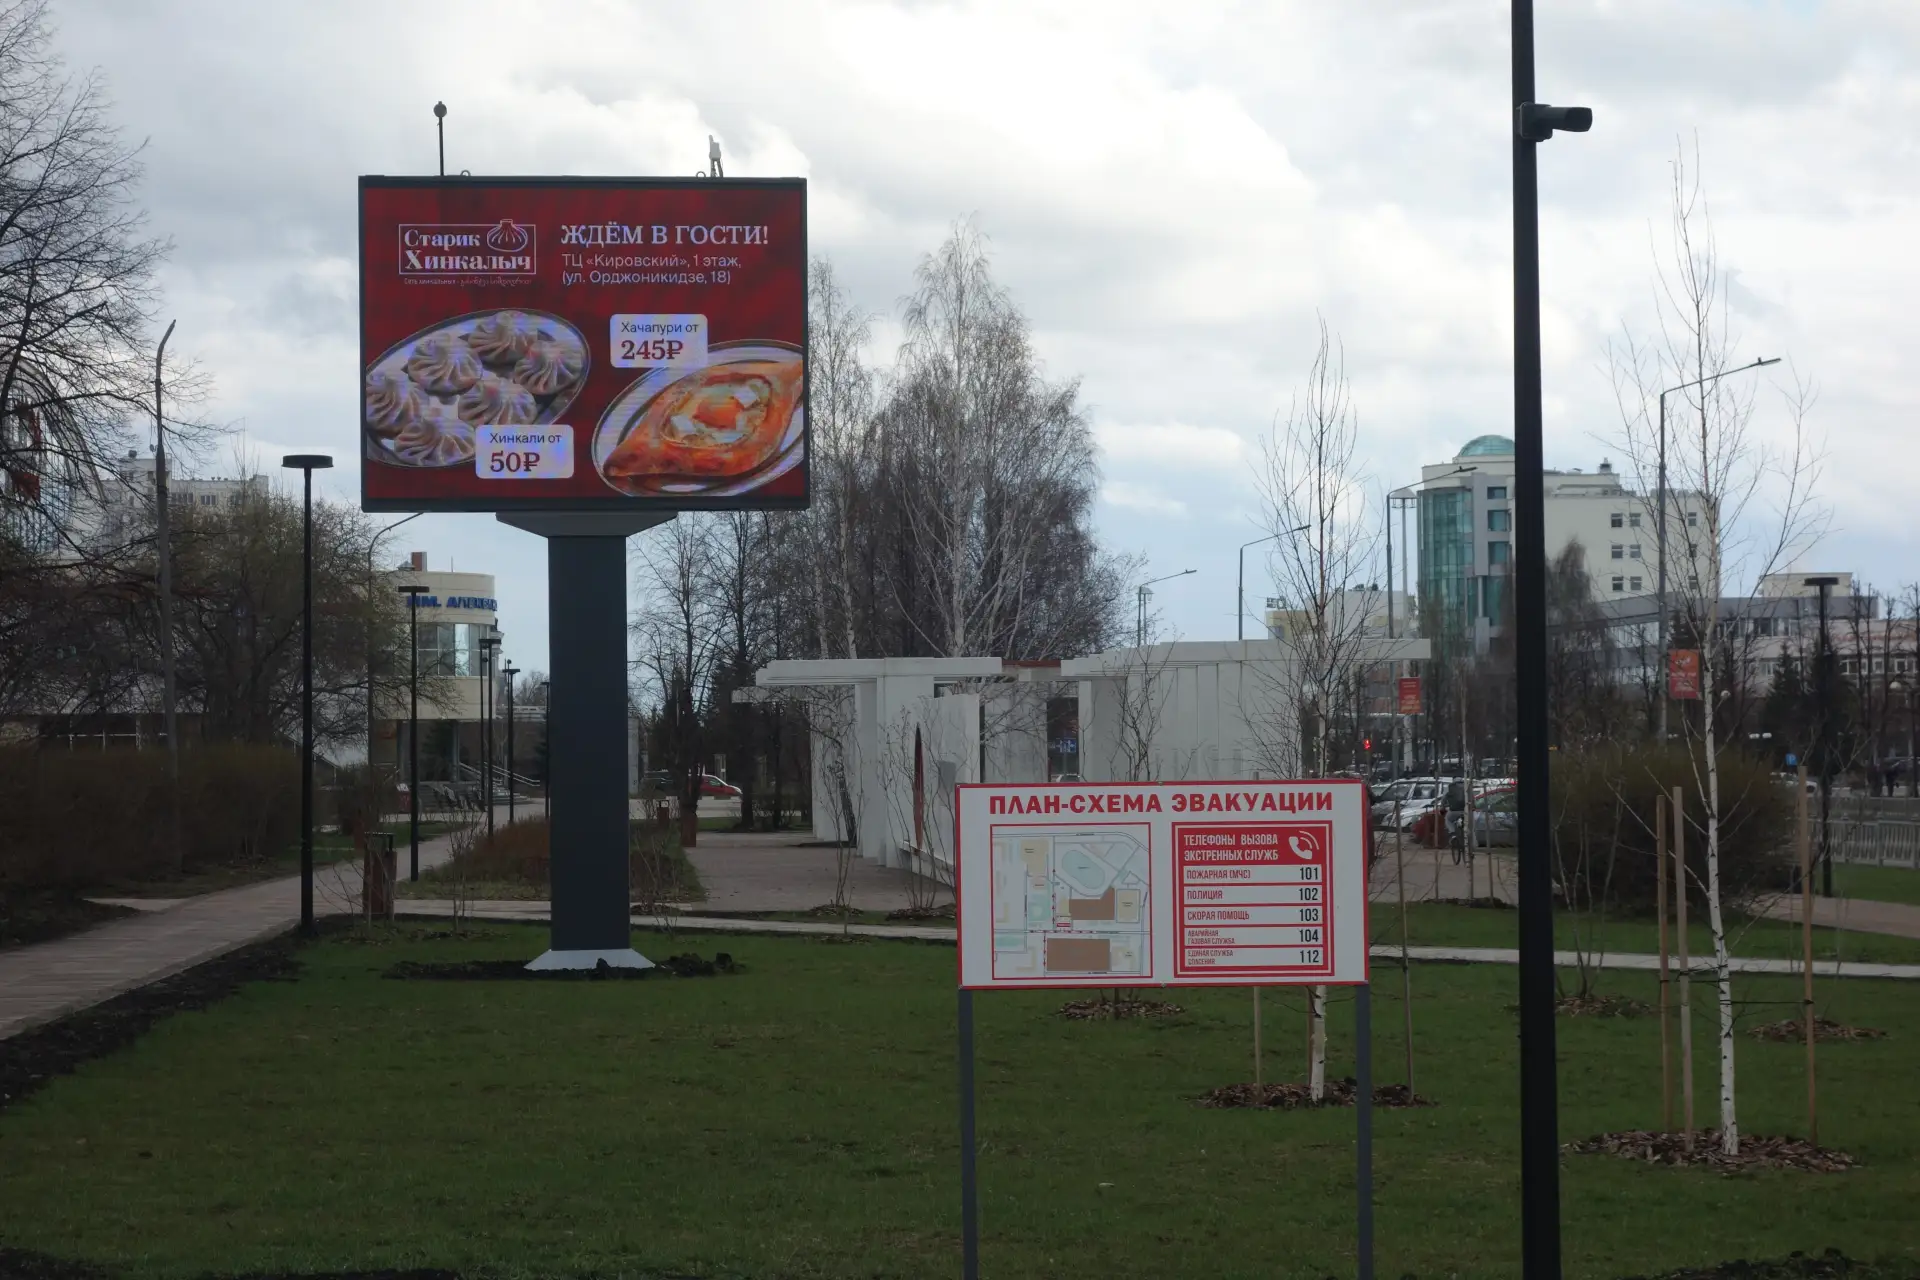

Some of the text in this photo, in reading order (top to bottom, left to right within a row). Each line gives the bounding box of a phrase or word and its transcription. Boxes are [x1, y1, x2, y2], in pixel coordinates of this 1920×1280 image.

[404, 229, 481, 251] Старик
[561, 221, 769, 248] ЖДЁМ В ГОСТИ!
[405, 250, 531, 270] Хинкалыч
[561, 253, 583, 268] ТЦ
[586, 253, 690, 269] «Кировский»,
[702, 257, 742, 269] этаж,
[562, 270, 731, 286] (ул. Орджоникидзе, 18)
[621, 321, 699, 337] Хачапури от
[489, 432, 562, 445] Хинкали от
[989, 792, 1333, 815] ПЛАН-СХЕМА ЭВАКУАЦИИ
[1184, 834, 1278, 846] ТЕЛЕФОНЫ ВЫЗОВА
[1184, 849, 1279, 861] ЭКСТРЕННЫХ СЛУЖБ
[1186, 870, 1228, 880] ПОЖАРНАЯ
[1299, 866, 1319, 881] 101
[1187, 887, 1319, 901] ПОЛИЦИЯ 102
[1187, 908, 1319, 922] СКОРАЯ ПОМОЩЬ 103
[1299, 929, 1319, 943] 104
[1299, 949, 1320, 964] 112
